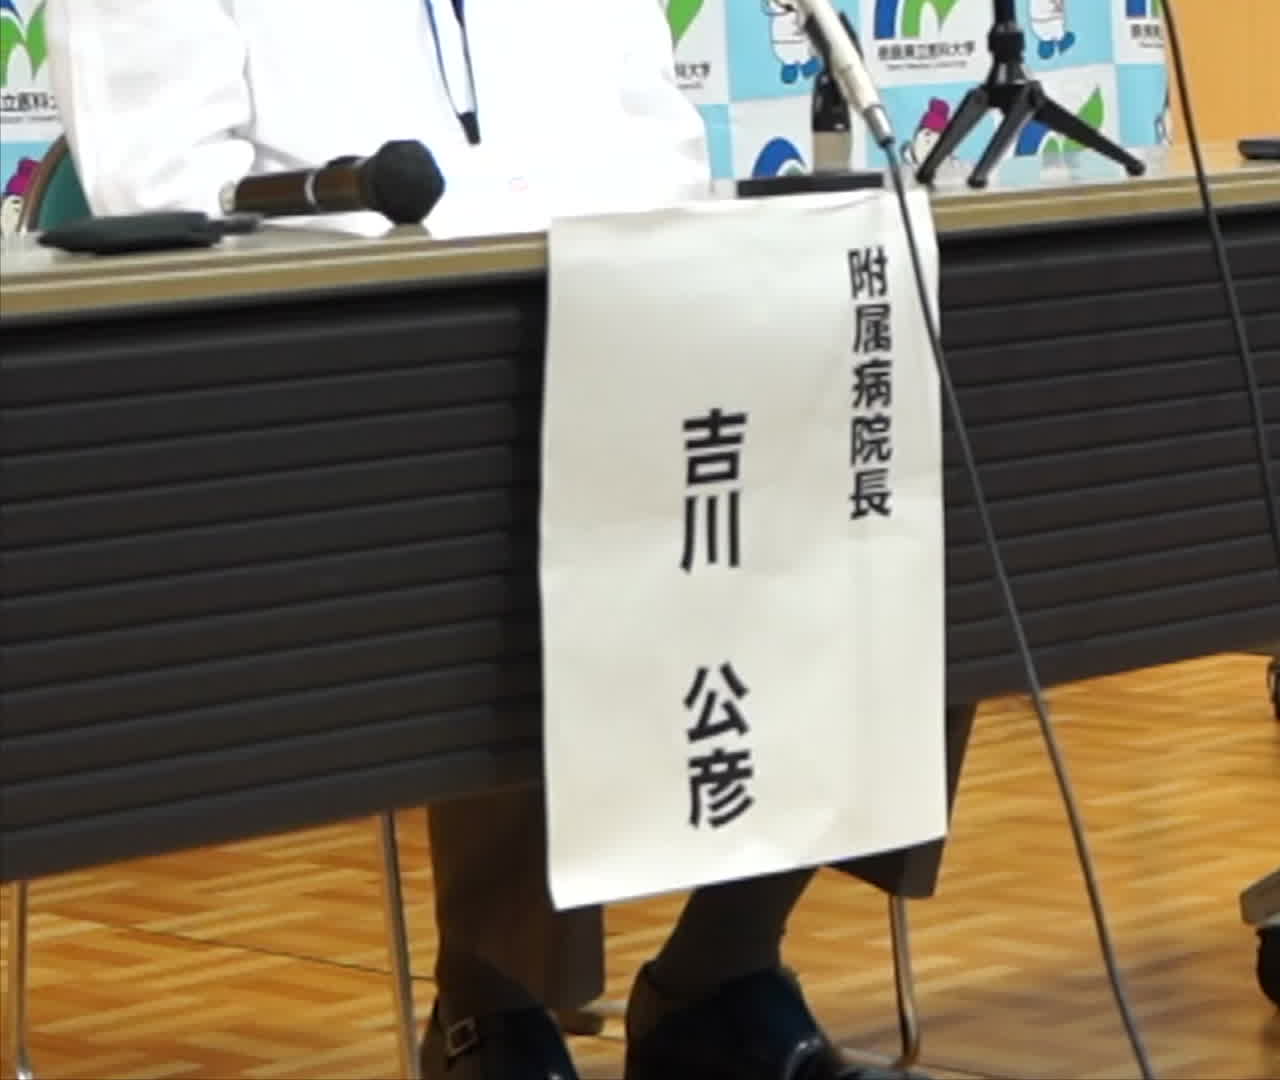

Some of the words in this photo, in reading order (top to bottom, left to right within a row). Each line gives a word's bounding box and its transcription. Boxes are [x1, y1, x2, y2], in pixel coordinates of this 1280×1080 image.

[847, 245, 893, 520] 附属病院長
[680, 408, 748, 575] 吉川
[683, 661, 755, 829] 公彦
